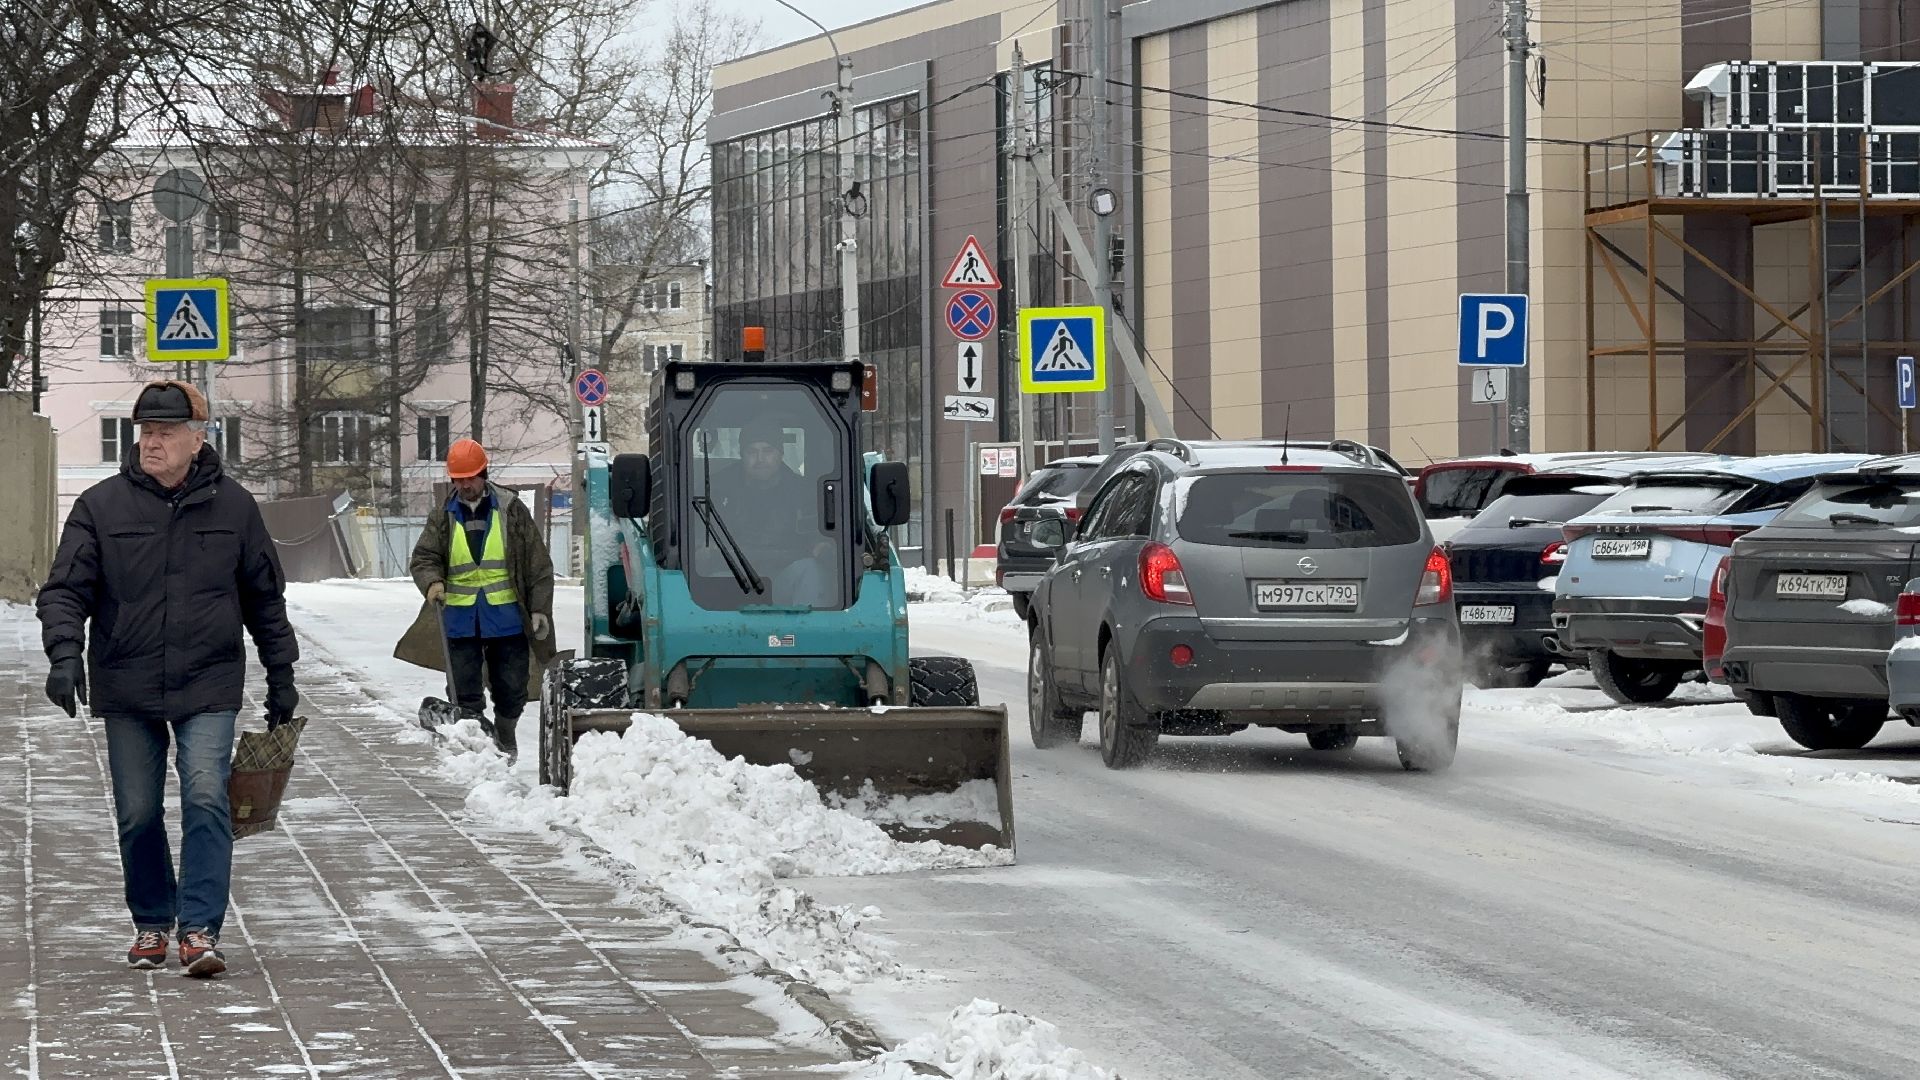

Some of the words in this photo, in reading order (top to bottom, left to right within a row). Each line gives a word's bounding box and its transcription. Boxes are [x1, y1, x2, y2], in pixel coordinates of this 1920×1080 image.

[1477, 302, 1515, 358] P
[1902, 363, 1912, 402] P
[1779, 577, 1823, 593] К694ТК
[1824, 576, 1844, 589] 790
[1262, 587, 1325, 603] М997СК
[1328, 586, 1353, 599] 790
[1498, 606, 1512, 616] 777
